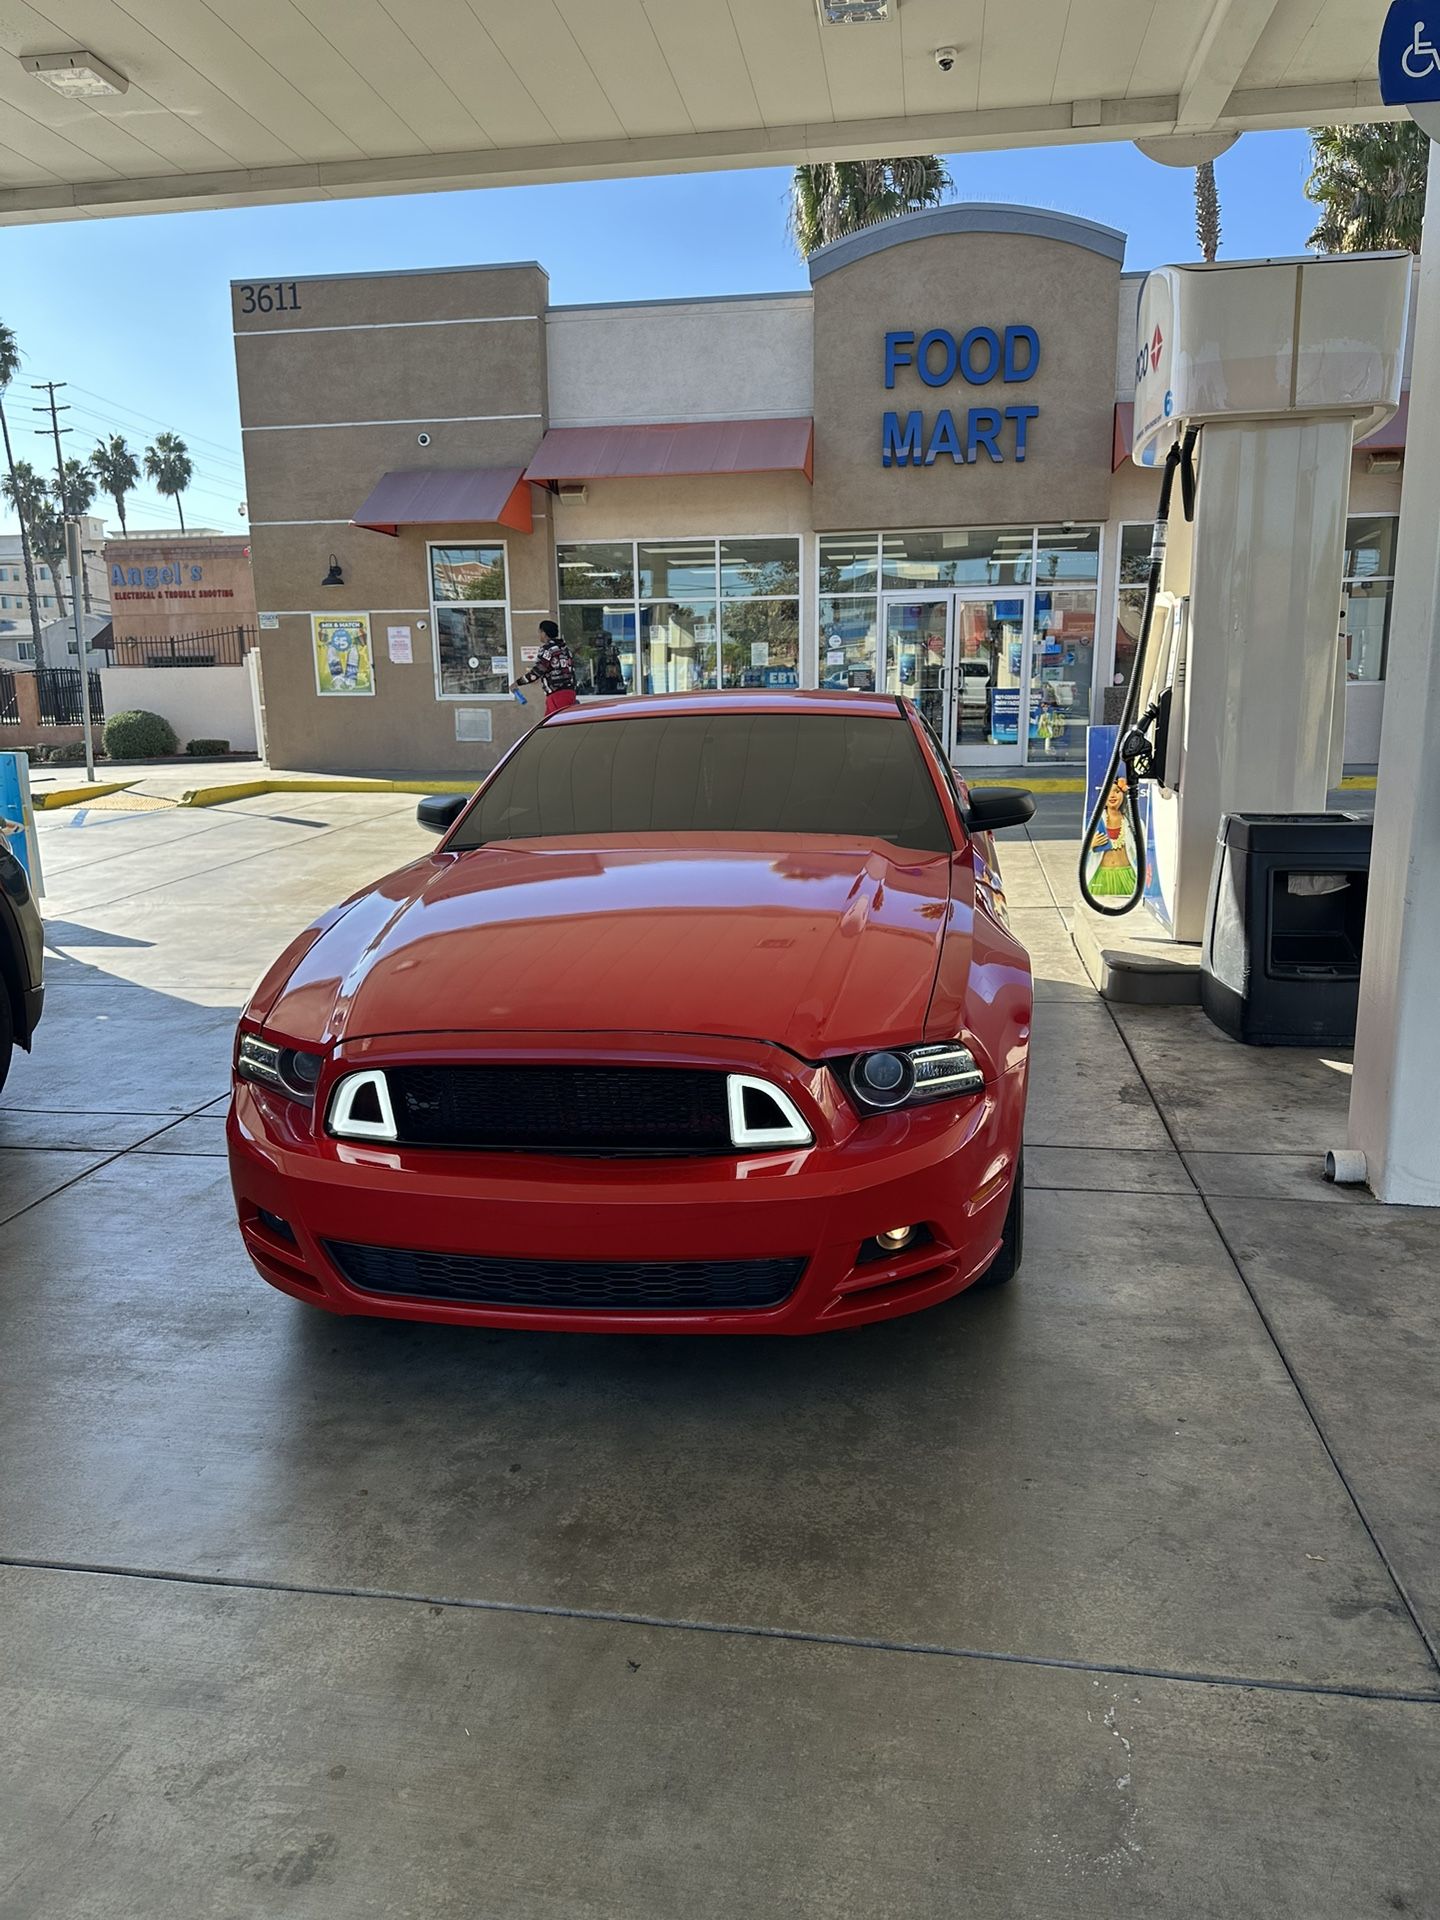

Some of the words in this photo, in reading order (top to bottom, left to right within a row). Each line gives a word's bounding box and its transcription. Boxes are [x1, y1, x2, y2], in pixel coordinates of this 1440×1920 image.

[240, 282, 302, 313] 3611
[884, 325, 1041, 389] FOOD
[1164, 390, 1173, 417] 6
[882, 405, 1040, 468] MART
[111, 560, 203, 589] Angel's
[114, 591, 156, 600] ELECTRICAL
[164, 590, 196, 599] TROUBLE
[199, 589, 234, 598] SHOOTING
[334, 636, 349, 649] $5
